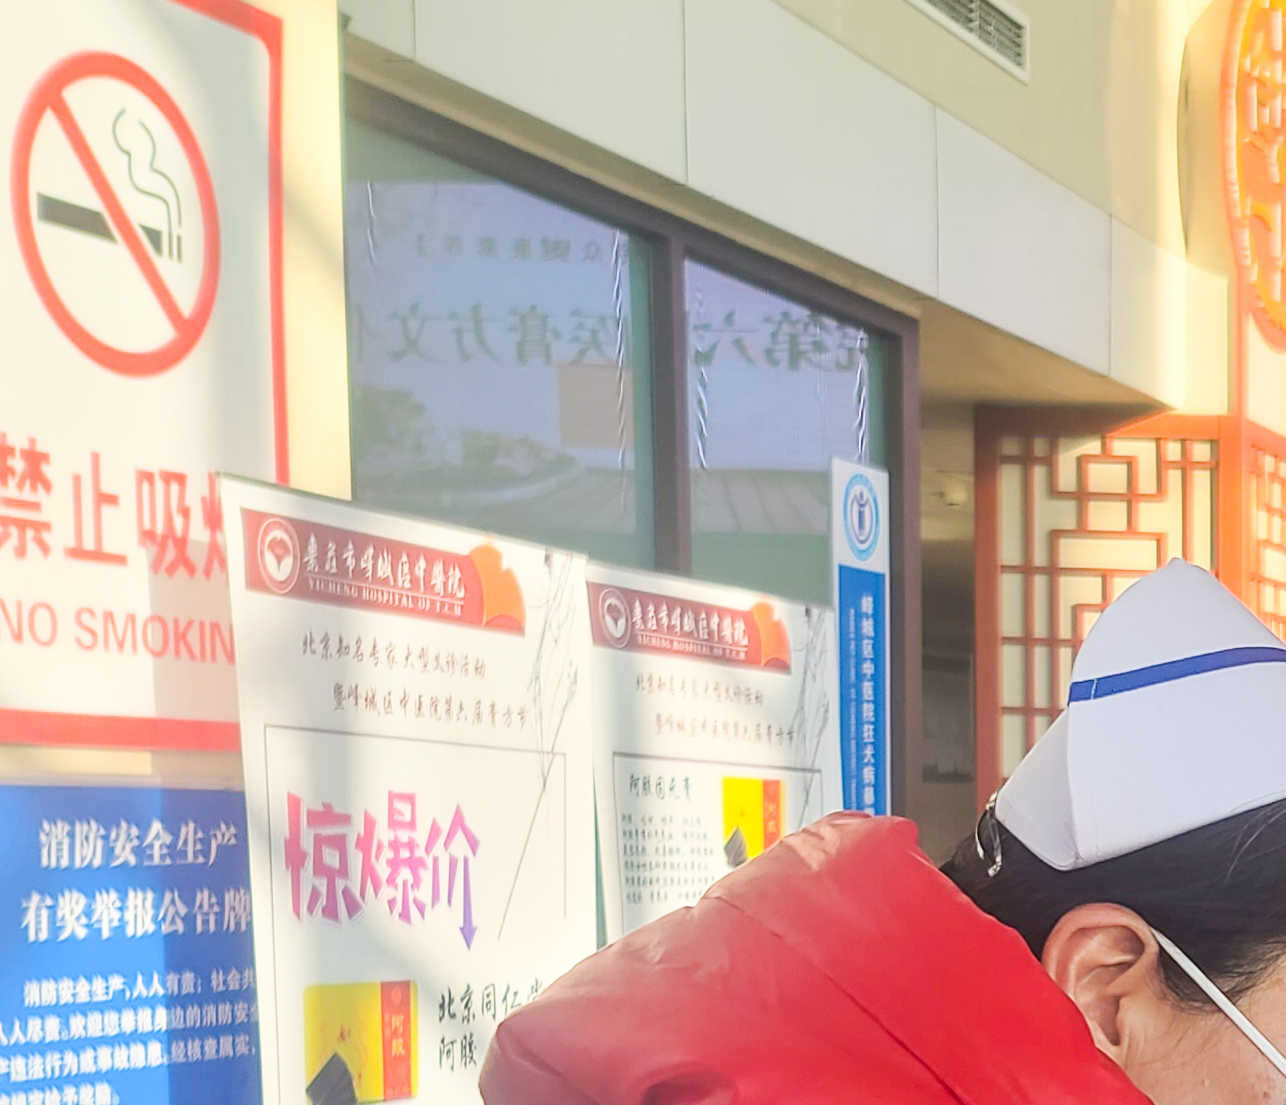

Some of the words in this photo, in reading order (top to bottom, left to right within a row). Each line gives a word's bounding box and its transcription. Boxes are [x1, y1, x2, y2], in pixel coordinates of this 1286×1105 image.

[0, 597, 59, 648] NO
[38, 816, 238, 869] 消防安全生产
[283, 789, 482, 951] 惊爆价
[20, 886, 250, 943] 有奖举报公告牌
